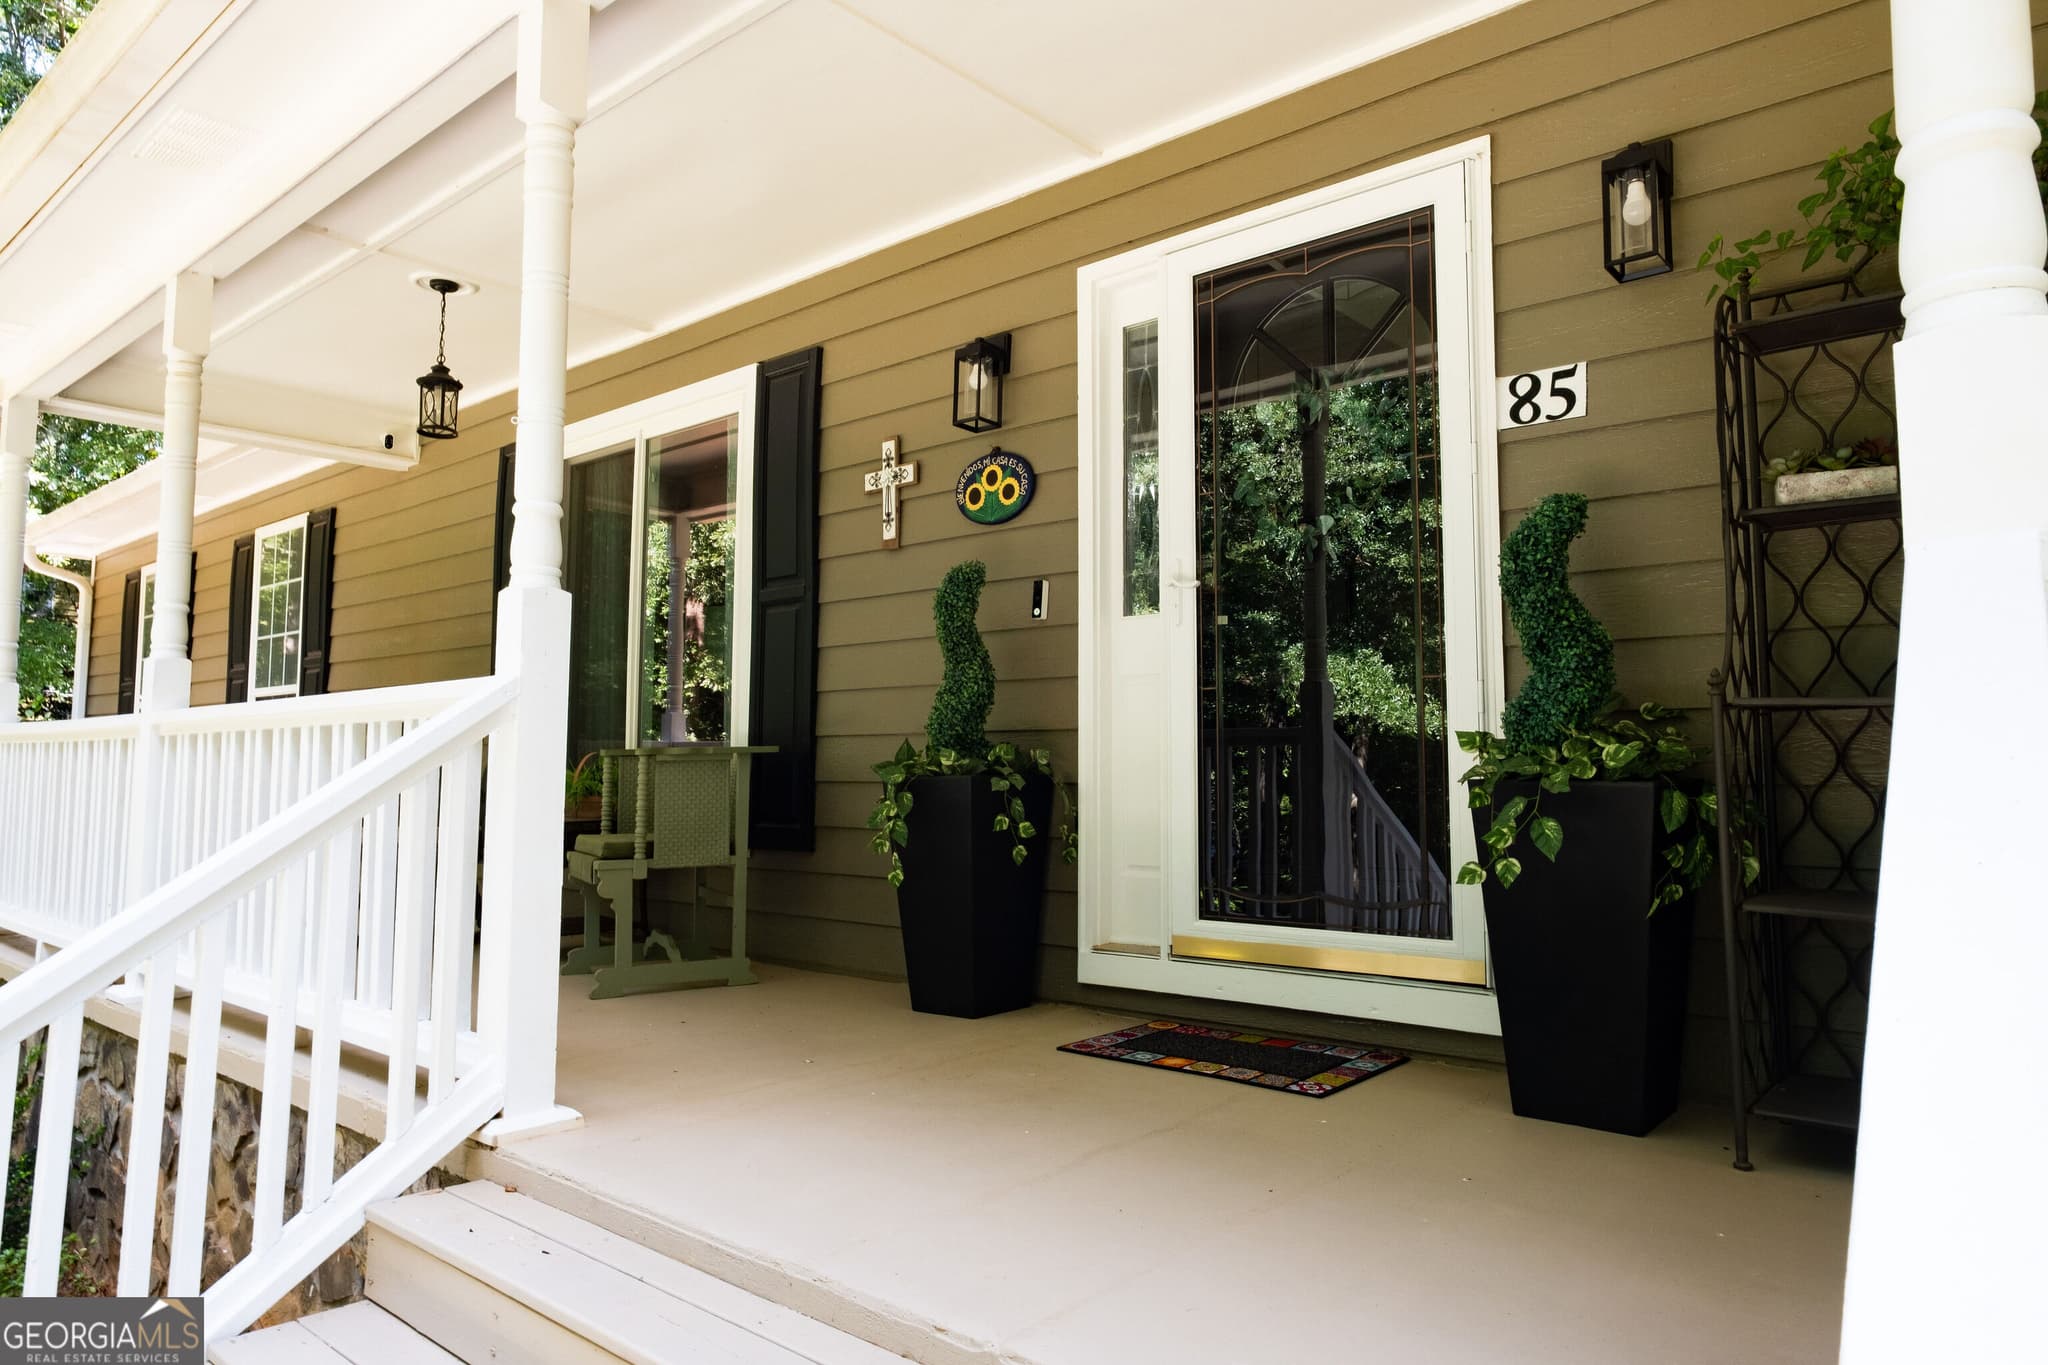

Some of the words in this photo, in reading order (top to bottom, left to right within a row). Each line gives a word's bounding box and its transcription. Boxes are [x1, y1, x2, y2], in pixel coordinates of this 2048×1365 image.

[1509, 363, 1578, 425] 85
[992, 456, 1008, 465] CASA
[1009, 458, 1017, 468] ES
[1016, 464, 1025, 474] SU
[1020, 474, 1029, 495] CASA
